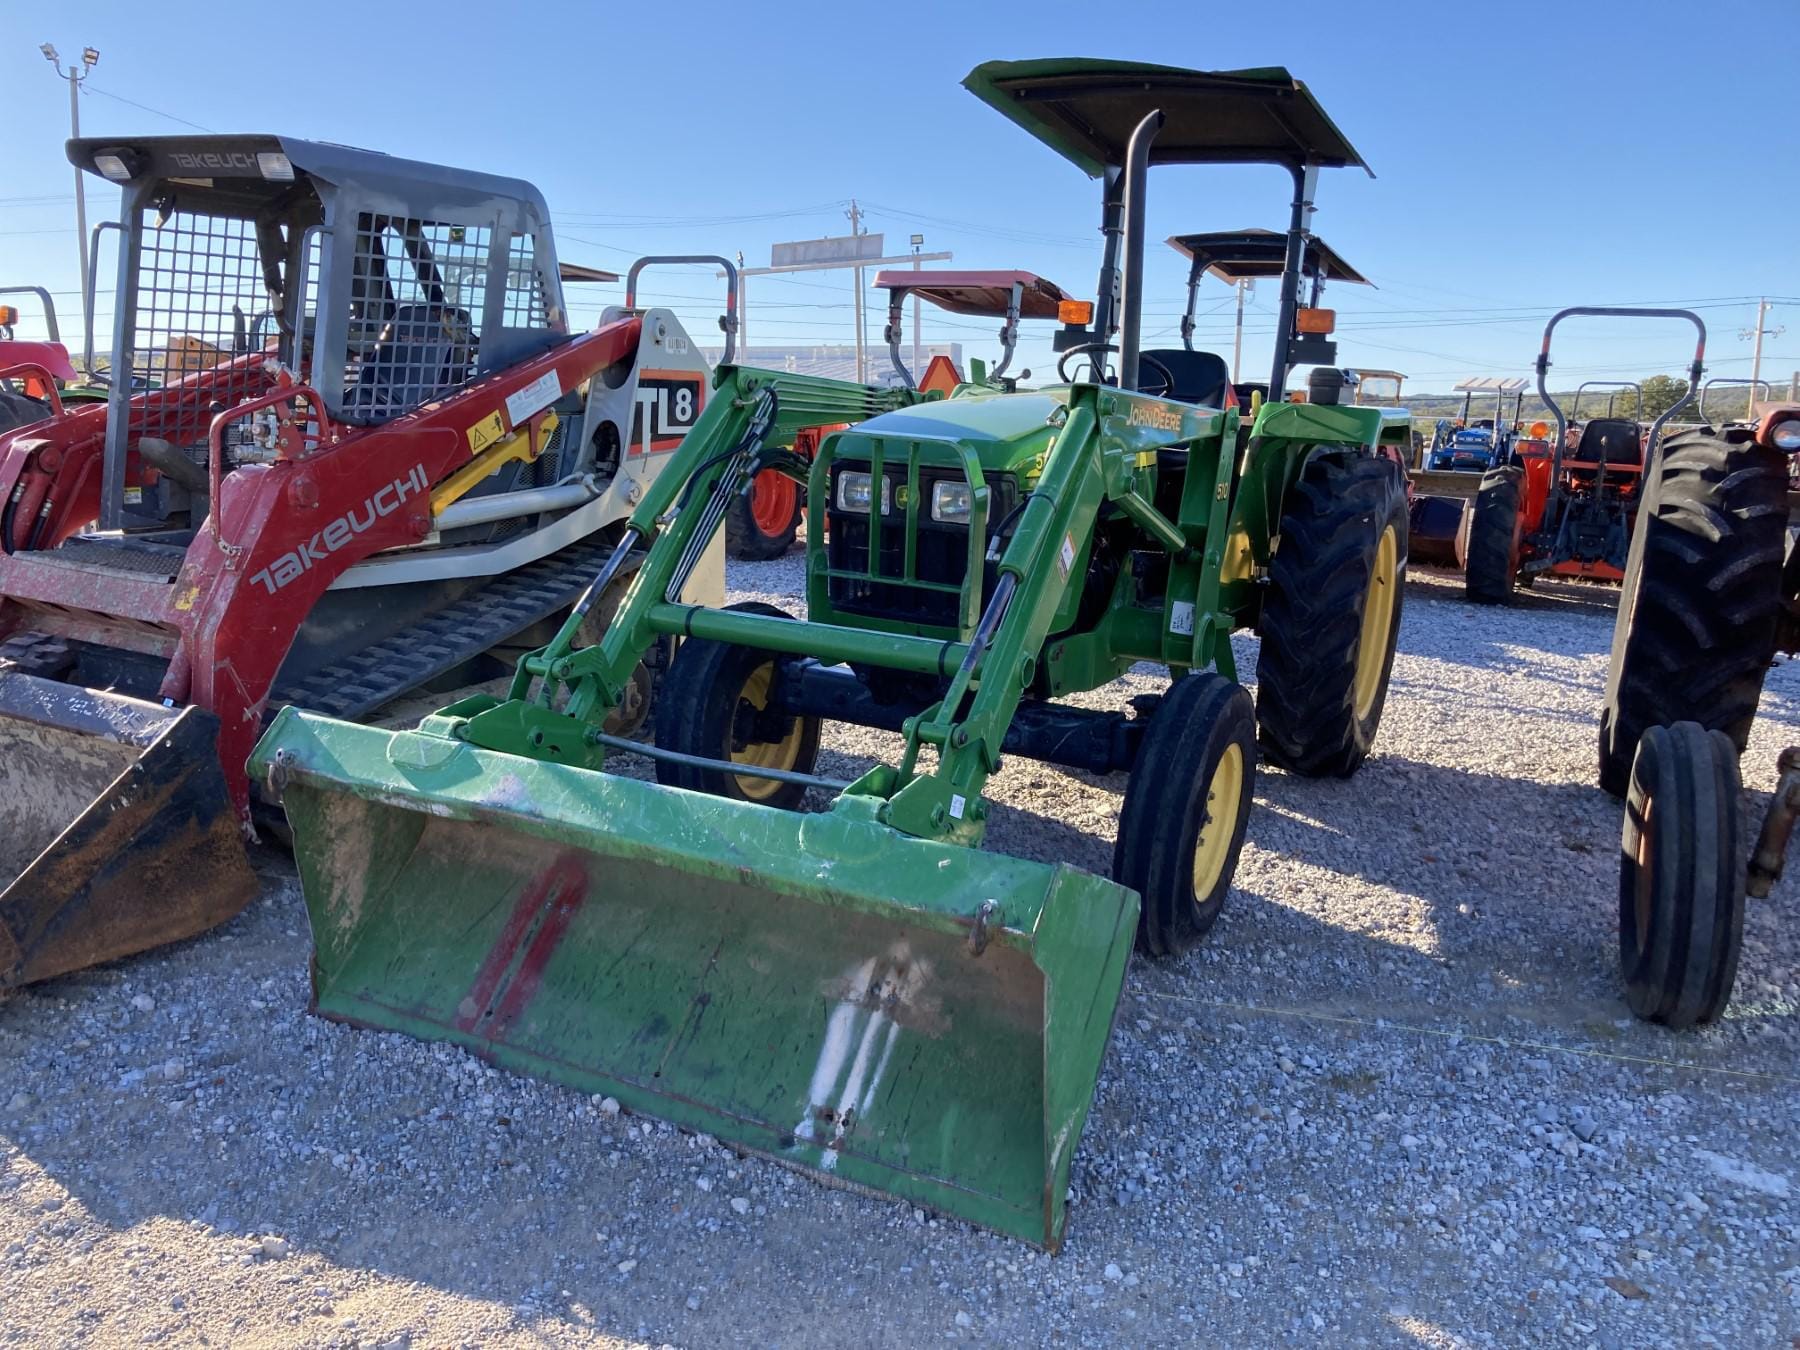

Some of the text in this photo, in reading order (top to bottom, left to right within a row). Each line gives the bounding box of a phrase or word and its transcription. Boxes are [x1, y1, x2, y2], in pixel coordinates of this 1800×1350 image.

[168, 152, 257, 168] TAKEUCH
[635, 386, 694, 453] TL8
[250, 463, 428, 595] TAKEUCHI
